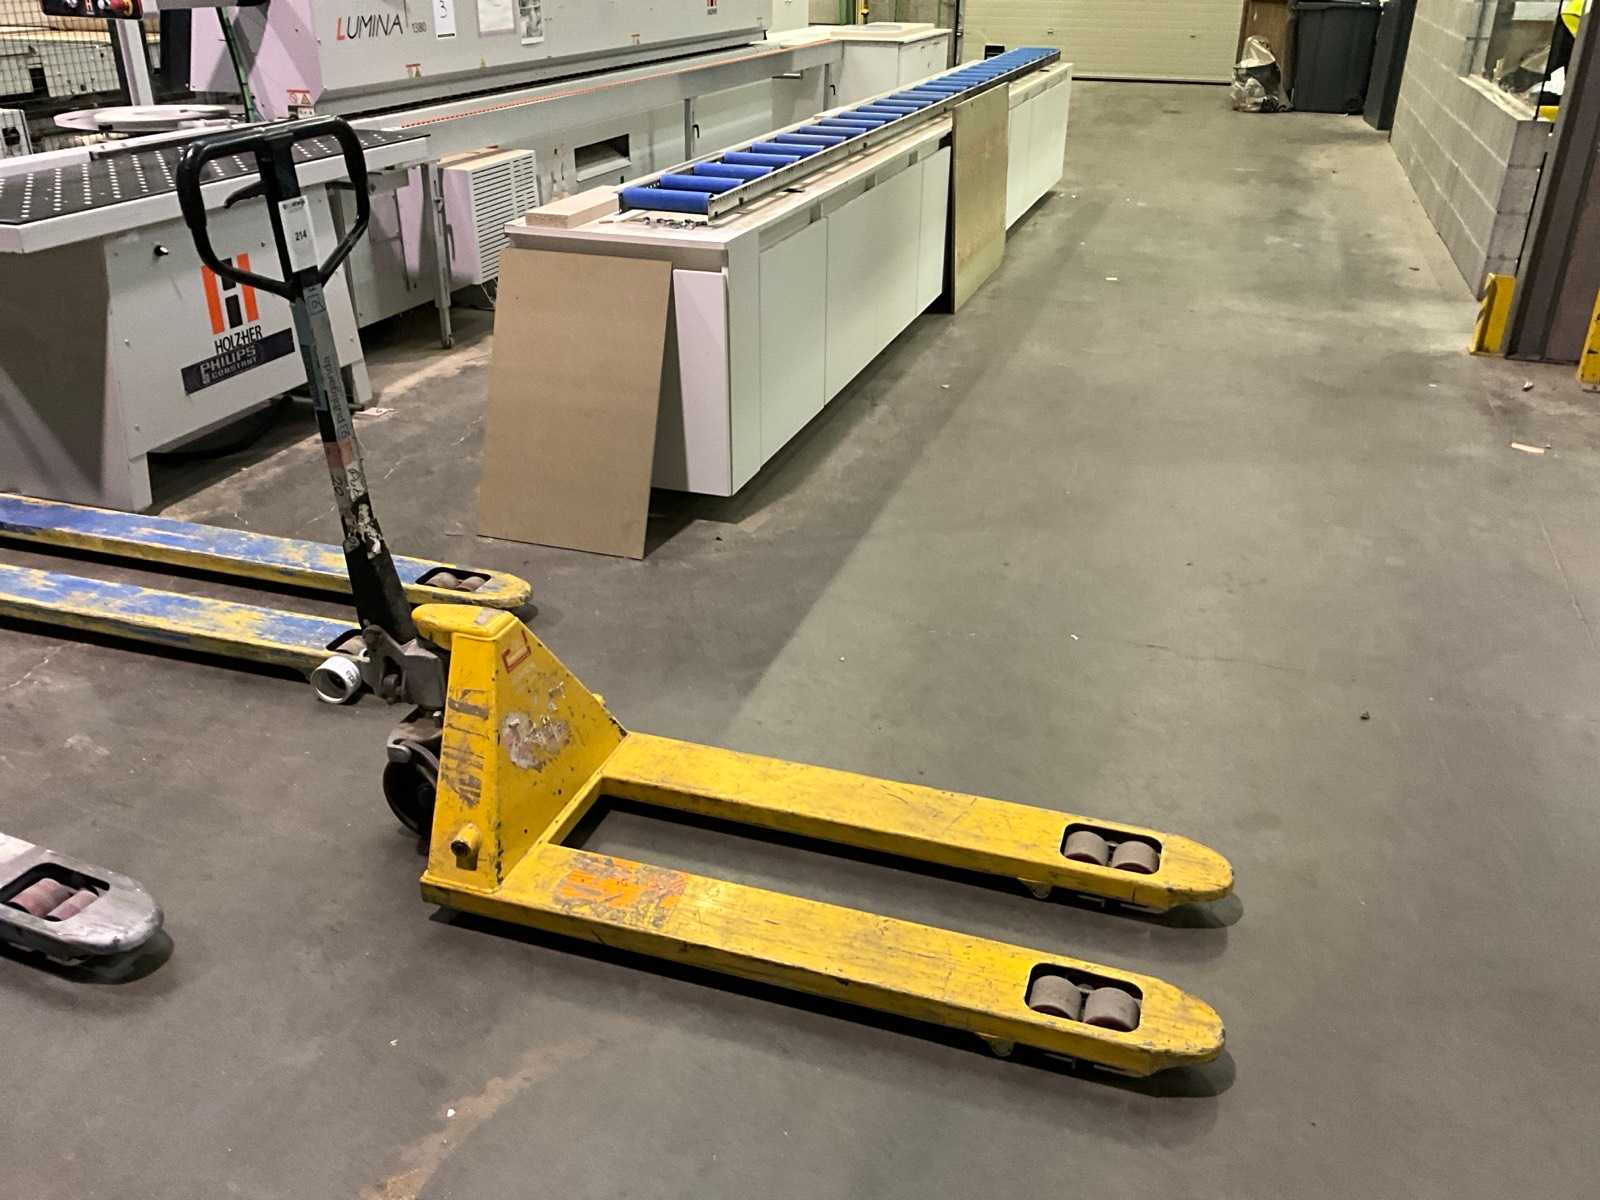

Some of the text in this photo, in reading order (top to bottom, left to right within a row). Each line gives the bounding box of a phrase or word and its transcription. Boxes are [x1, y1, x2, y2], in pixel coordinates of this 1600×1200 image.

[336, 14, 404, 41] LUMINA
[295, 229, 308, 241] 214
[214, 325, 263, 354] HOLZHER
